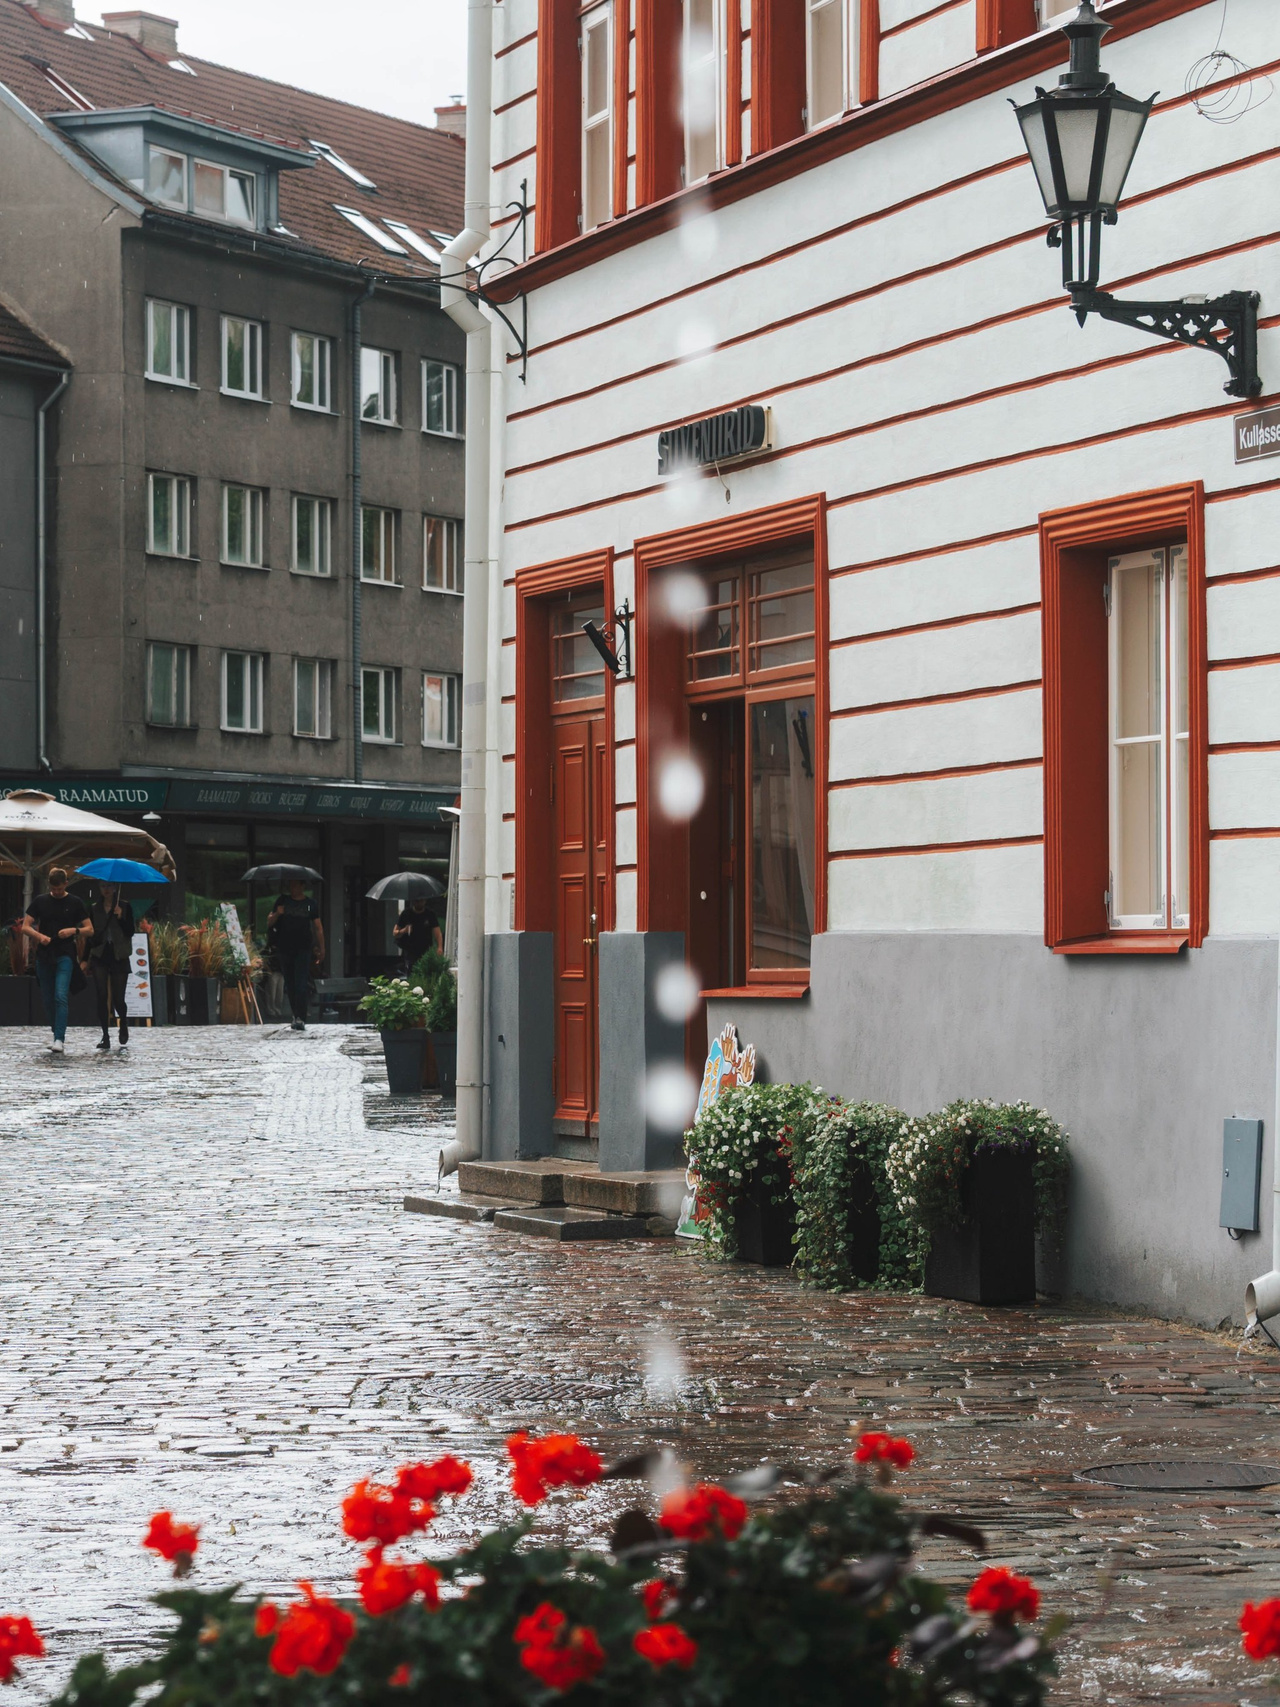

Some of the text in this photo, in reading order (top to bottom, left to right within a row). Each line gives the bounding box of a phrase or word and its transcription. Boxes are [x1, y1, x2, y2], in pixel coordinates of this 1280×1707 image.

[58, 788, 150, 803] RAAMATUD
[197, 790, 241, 804] RAAMATUD
[279, 791, 307, 806] BÜCHER
